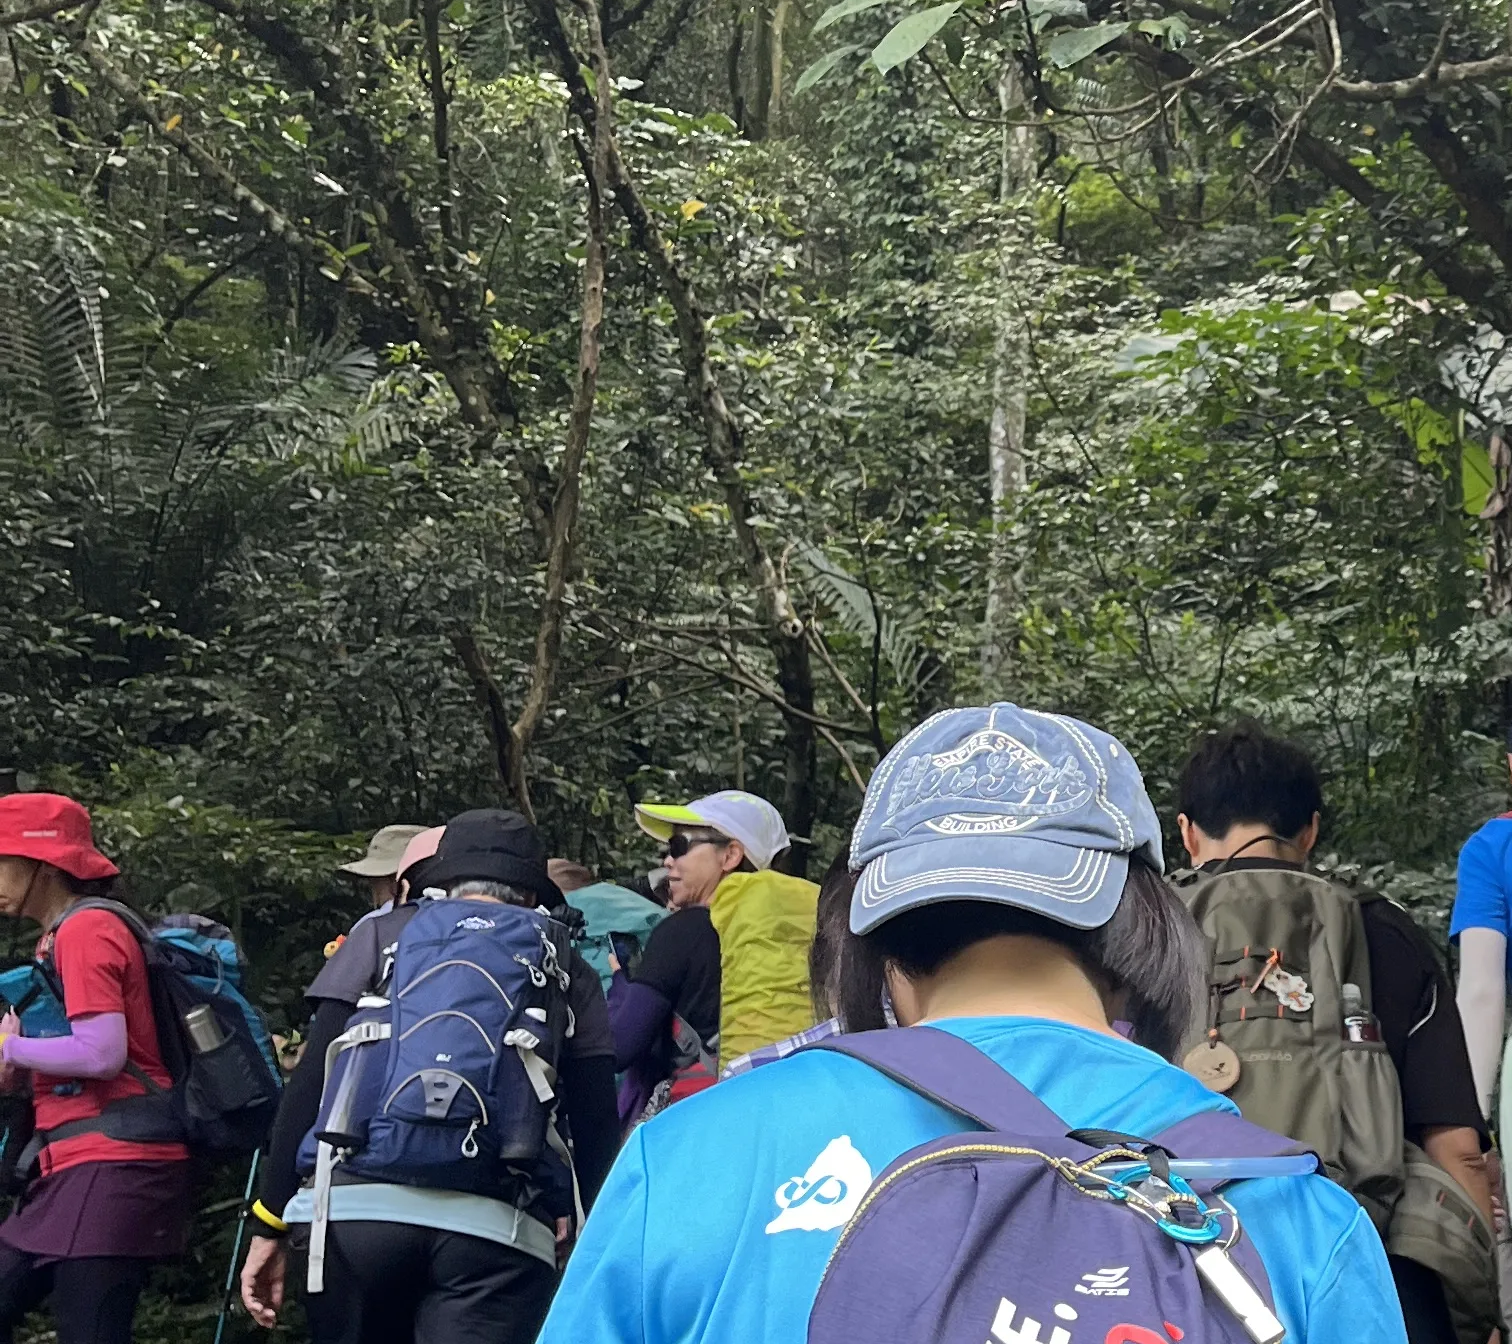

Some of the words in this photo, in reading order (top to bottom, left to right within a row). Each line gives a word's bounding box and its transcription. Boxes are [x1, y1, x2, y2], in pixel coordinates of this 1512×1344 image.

[931, 733, 990, 769] EMPIRE
[993, 735, 1042, 772] STATE
[886, 752, 977, 816] New
[976, 750, 1088, 800] York
[939, 814, 1019, 832] BUILDING
